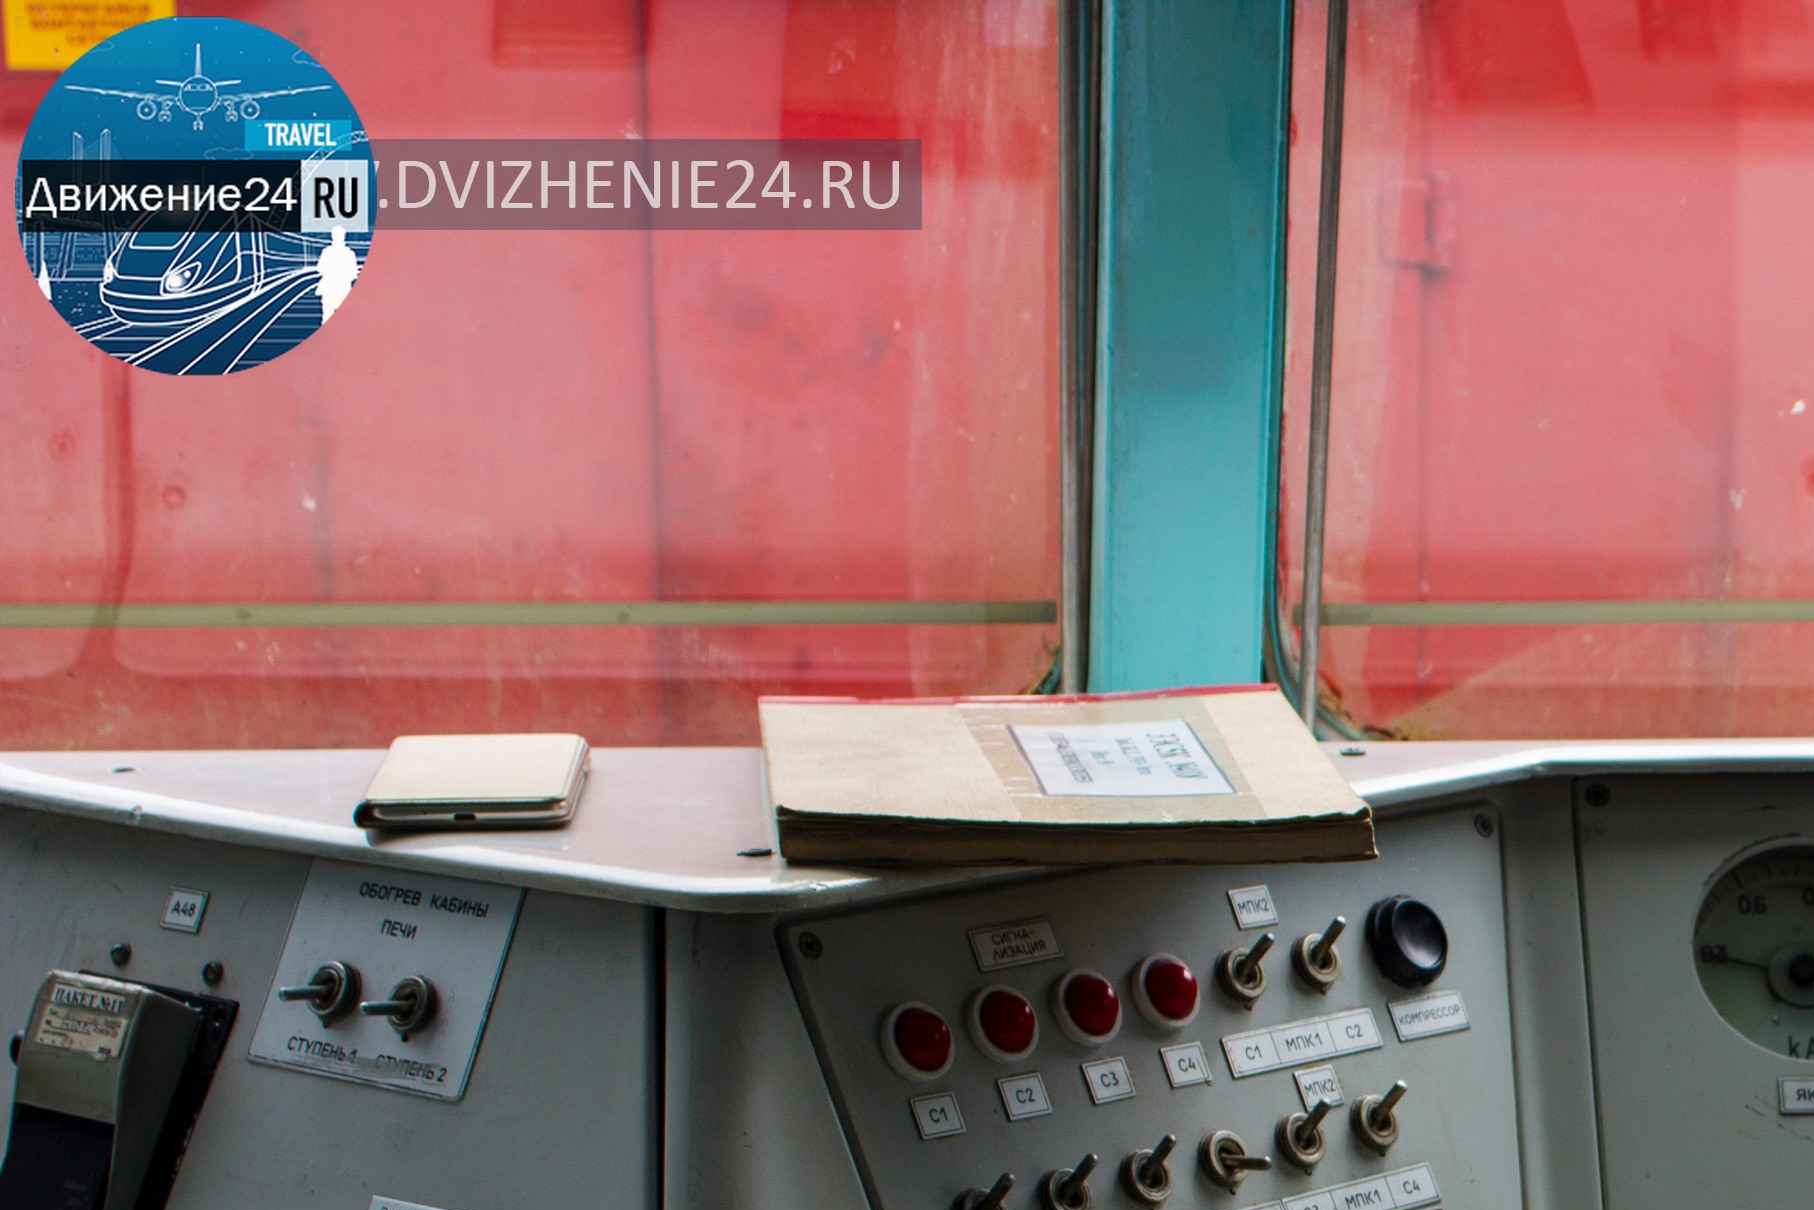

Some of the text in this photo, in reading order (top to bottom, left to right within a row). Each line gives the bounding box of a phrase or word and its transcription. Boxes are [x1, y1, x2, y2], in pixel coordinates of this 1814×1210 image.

[359, 881, 489, 919] ОБОГРЕВ КАБИНЫ
[1237, 898, 1270, 915] МПК2
[381, 919, 417, 940] ПЕЧИ
[991, 930, 1035, 947] СИГНА-
[992, 939, 1047, 961] ЛИЗАЦИЯ
[1397, 1005, 1461, 1027] КОМПРЕССОР
[1345, 1024, 1363, 1040] С2
[288, 1035, 358, 1064] СТУПЕНЬ 1
[1285, 1033, 1323, 1052] МПК1
[1245, 1045, 1262, 1061] С1
[375, 1054, 448, 1083] СТУПЕНЬ 2
[1177, 1054, 1197, 1072] С4
[1099, 1071, 1119, 1088] С3
[1304, 1077, 1337, 1098] МПК2
[1015, 1088, 1036, 1104] С2
[928, 1109, 949, 1124] С1
[1402, 1177, 1421, 1196] С4
[1345, 1187, 1382, 1210] МПК1
